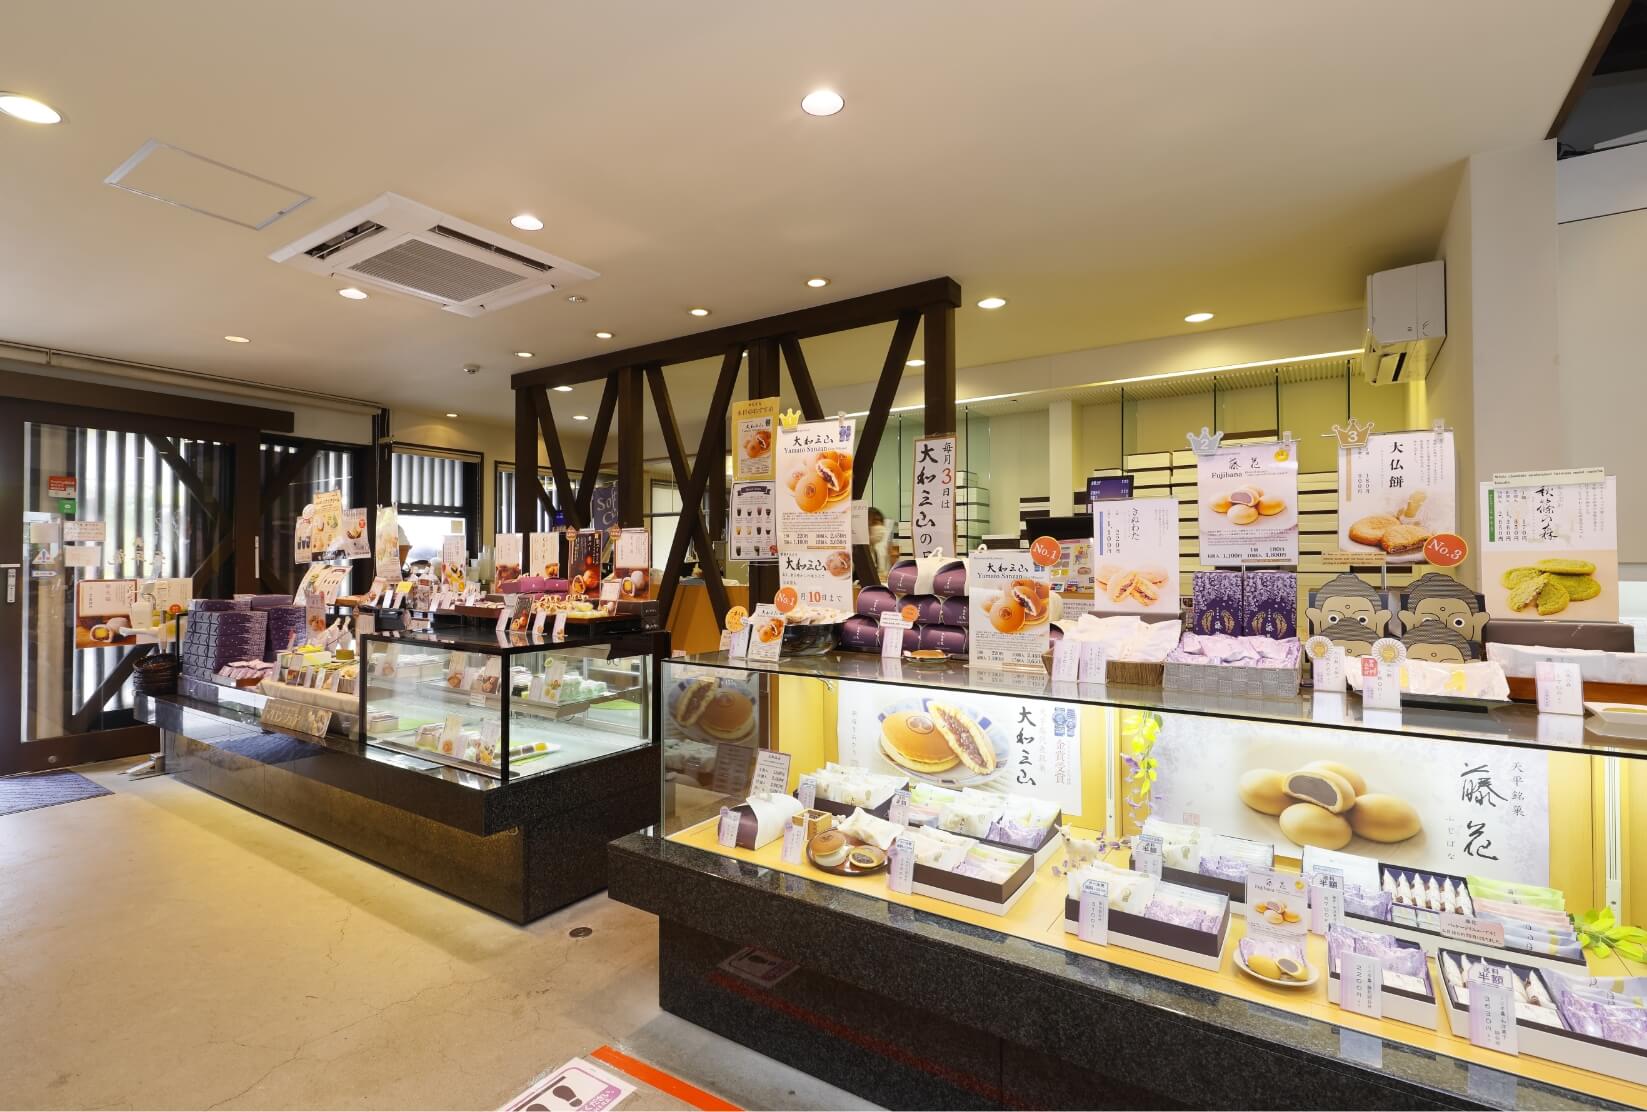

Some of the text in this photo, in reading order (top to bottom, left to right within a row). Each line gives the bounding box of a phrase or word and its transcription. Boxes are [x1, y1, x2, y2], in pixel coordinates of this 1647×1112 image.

[793, 434, 834, 447] 大和三山
[1200, 438, 1209, 449] 2
[1347, 430, 1358, 442] 3
[1389, 441, 1404, 488] 大仏餅
[941, 441, 953, 509] 毎月3日は
[1033, 542, 1058, 560] No.1
[1428, 539, 1462, 560] No.3
[785, 557, 827, 571] 大和三山
[986, 562, 1029, 573] 大和三山
[1016, 706, 1037, 786] 大和三山
[1460, 762, 1509, 861] 藤花
[1479, 972, 1504, 984] 半額
